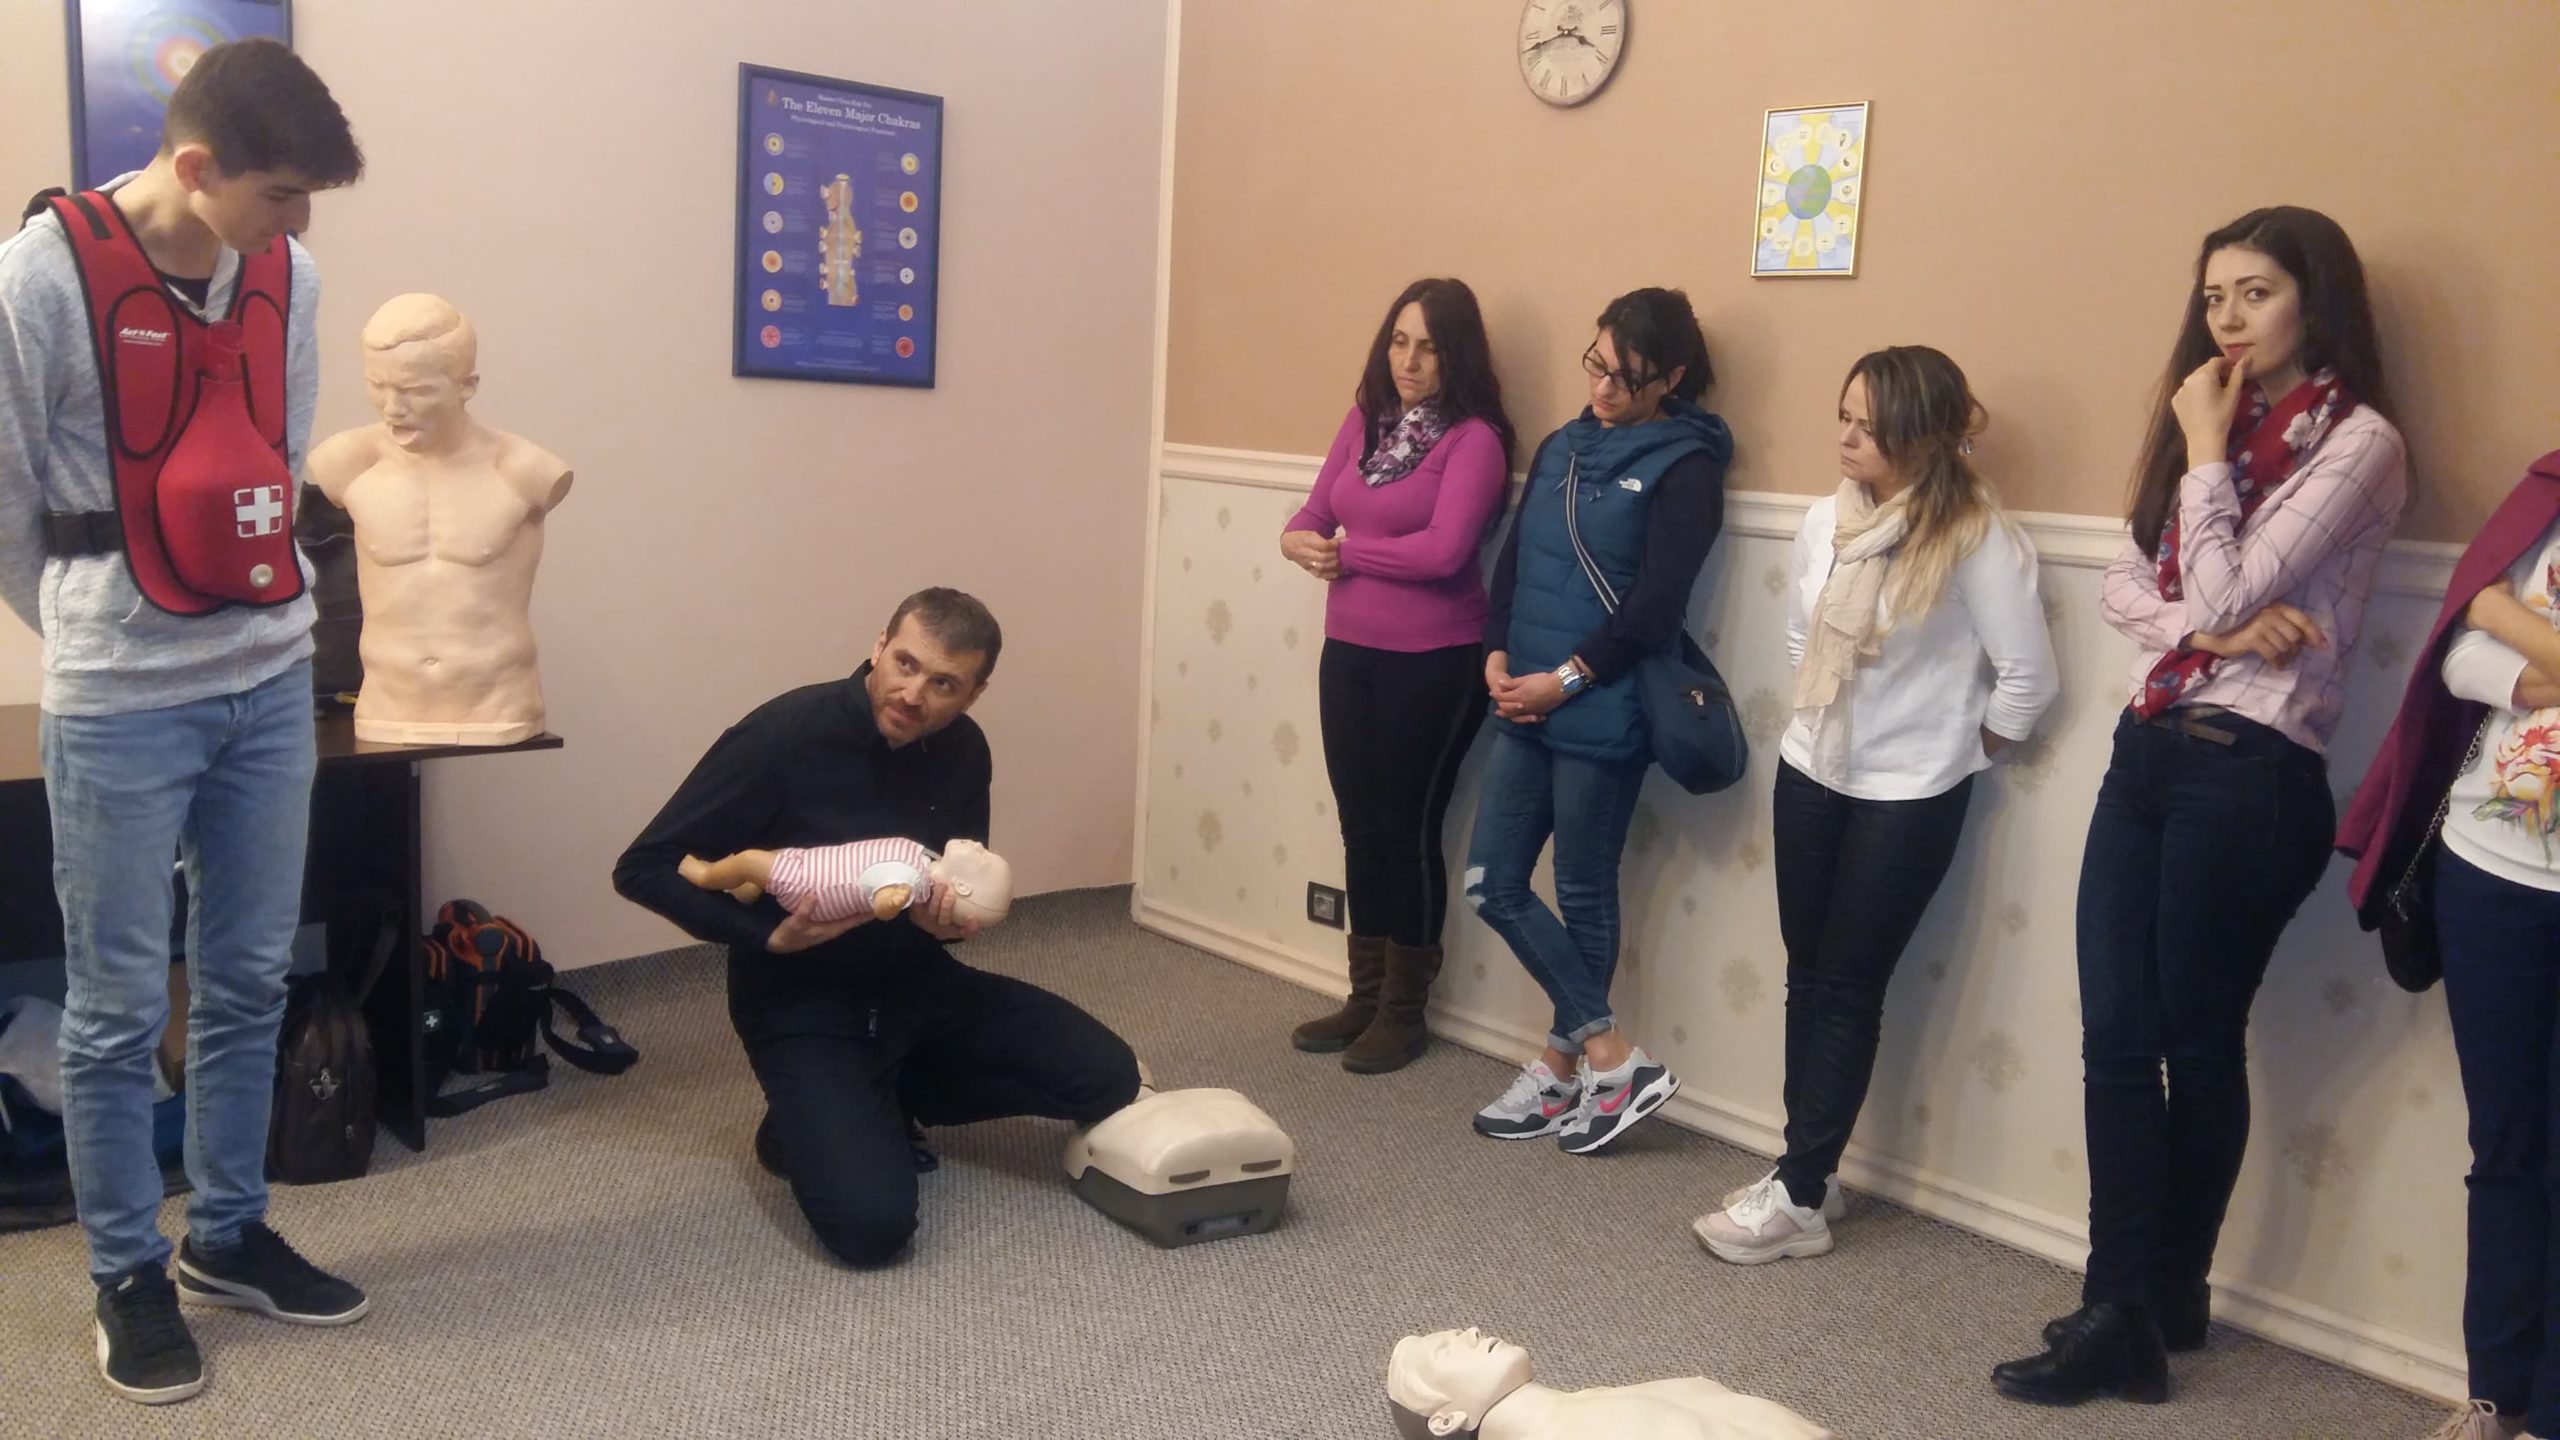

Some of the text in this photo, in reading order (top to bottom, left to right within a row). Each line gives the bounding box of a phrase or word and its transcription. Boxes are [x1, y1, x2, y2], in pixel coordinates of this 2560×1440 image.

[782, 97, 803, 111] The
[806, 101, 842, 117] Eleven
[845, 108, 876, 123] Major
[877, 113, 921, 129] Chakras
